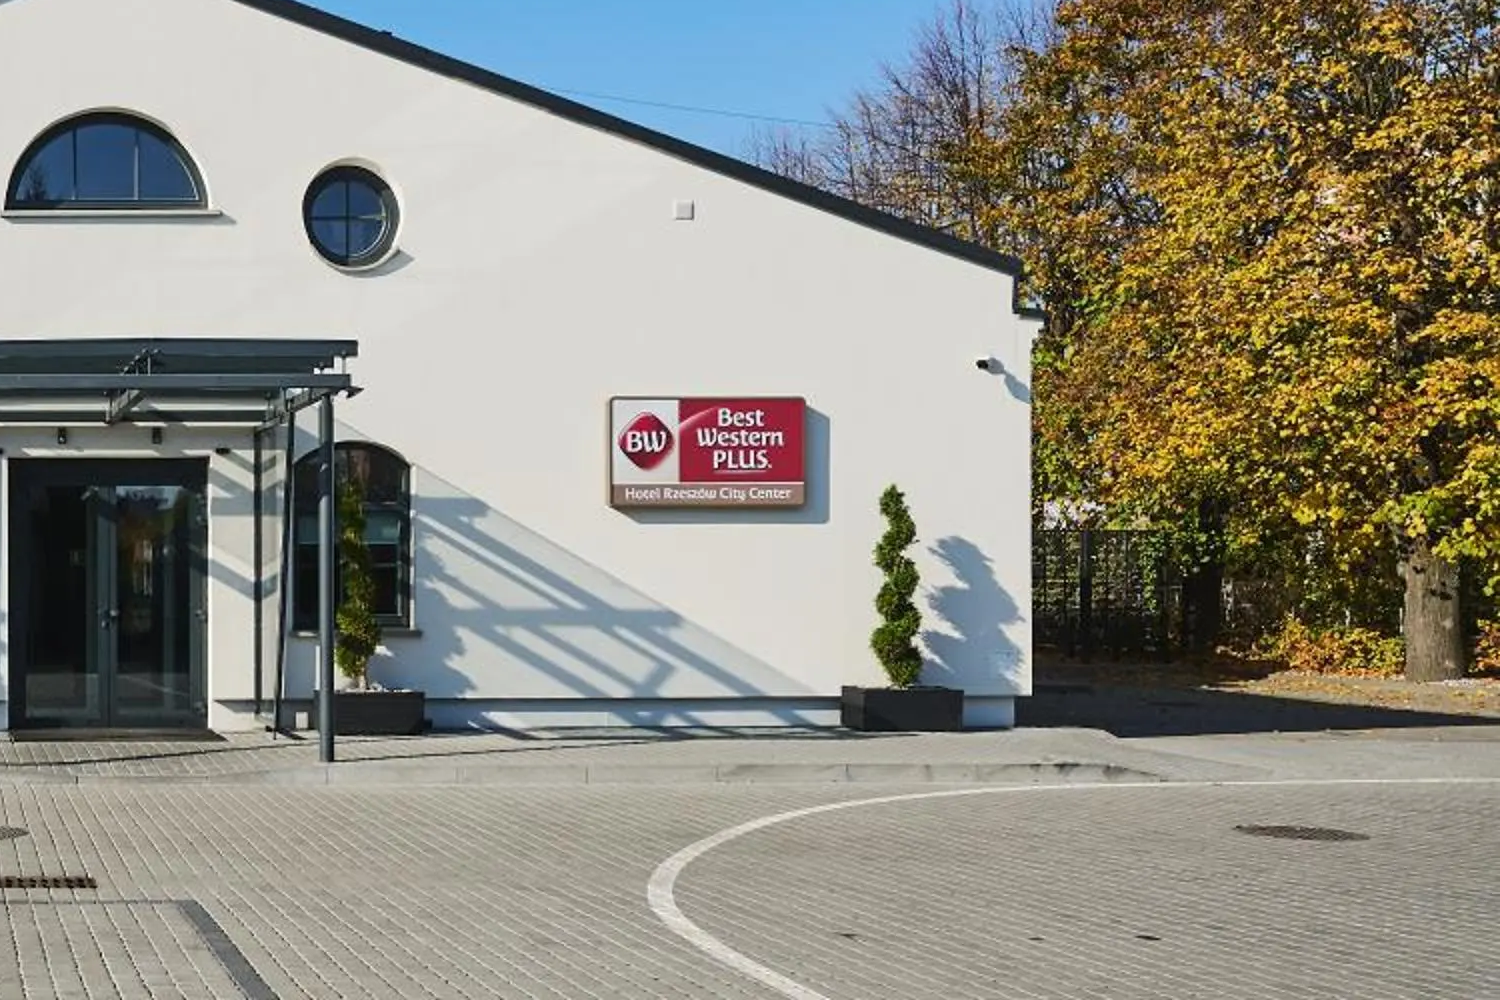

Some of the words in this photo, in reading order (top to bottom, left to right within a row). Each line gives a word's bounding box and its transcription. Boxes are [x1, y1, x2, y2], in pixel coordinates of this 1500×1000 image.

[717, 408, 764, 426] Best
[626, 431, 666, 452] BW
[697, 429, 783, 446] Western
[625, 487, 661, 500] Hotel
[719, 487, 746, 501] City
[749, 487, 792, 500] Center
